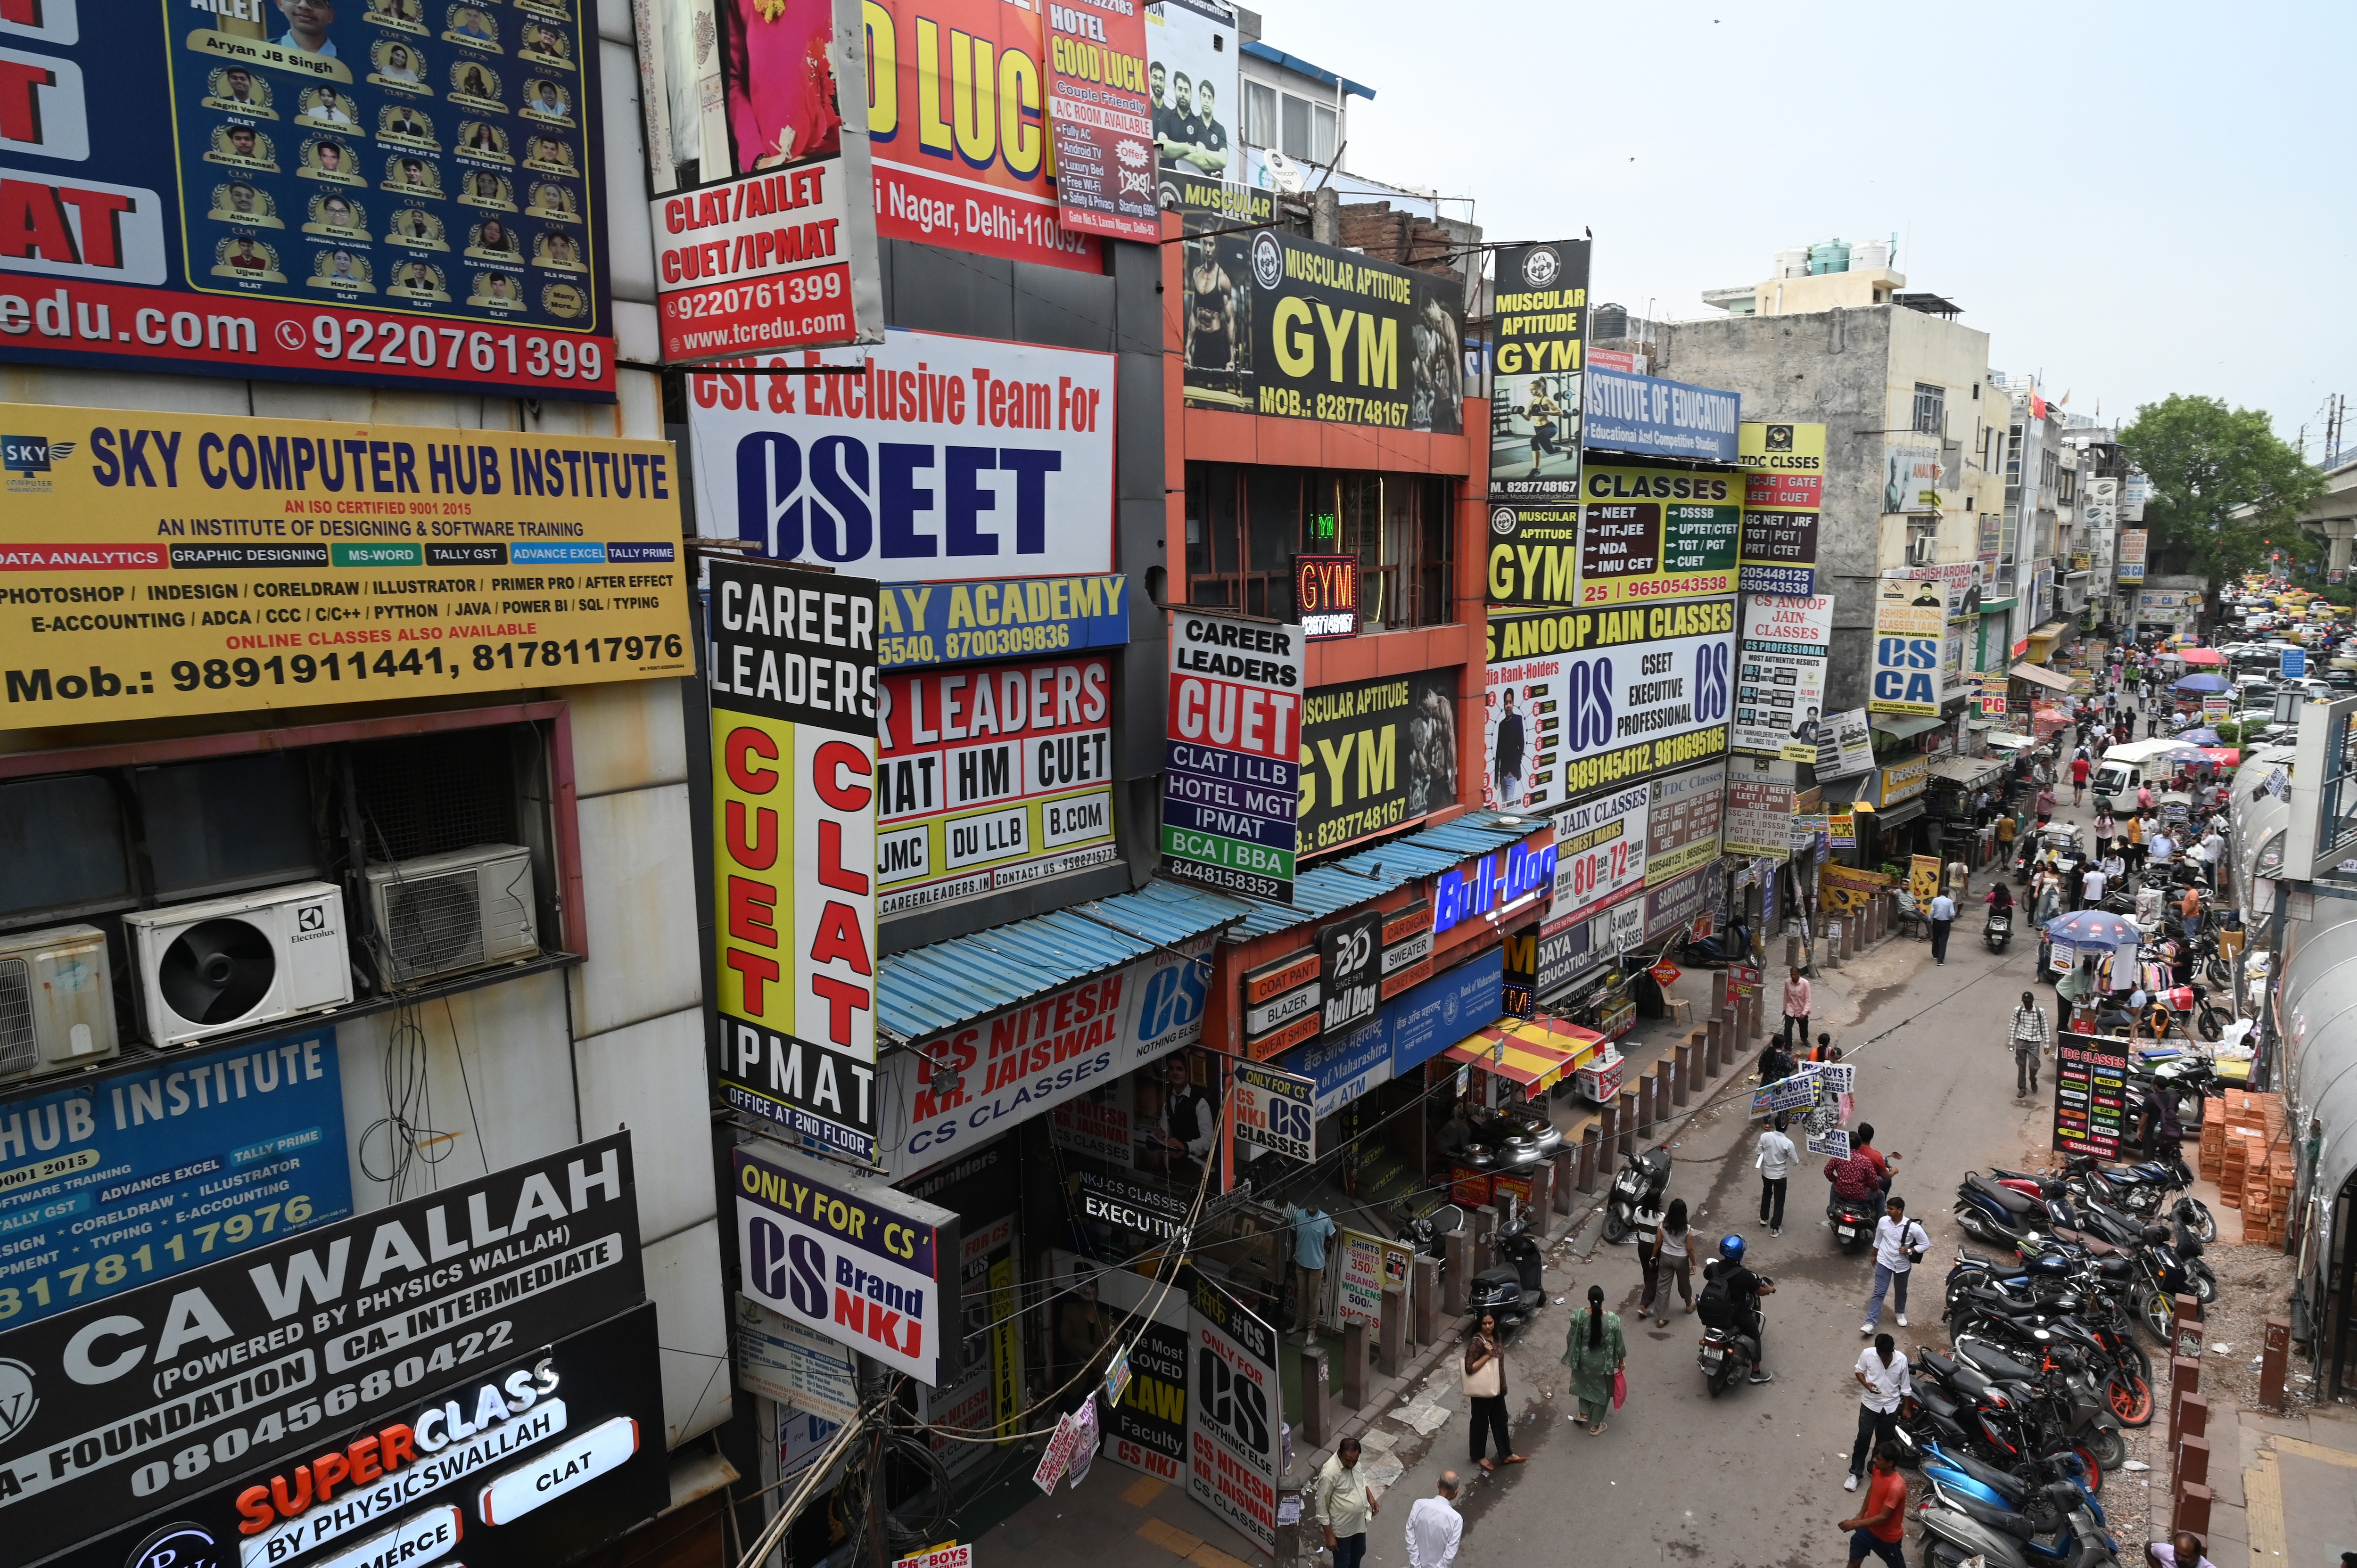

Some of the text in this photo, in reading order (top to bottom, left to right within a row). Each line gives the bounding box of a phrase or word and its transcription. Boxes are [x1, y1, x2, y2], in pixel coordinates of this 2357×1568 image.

[1050, 4, 1106, 43] HOTEL
[206, 36, 333, 74] Aryan JB Singh
[1052, 34, 1146, 95] GOOD LUCK
[1058, 81, 1146, 115] Couple Friendly
[1056, 100, 1149, 136] A/C ROOM AVAILABLE
[1065, 158, 1104, 176] Luxury Bed
[1121, 148, 1143, 160] Offer
[665, 166, 825, 234] CLAT/AILET
[662, 218, 838, 284] CUET/IPMAT
[1286, 248, 1410, 305] MUSCULAR APTITUDE
[553, 292, 575, 302] Many
[678, 272, 841, 319] 9220761399
[684, 313, 846, 349] www.tcredu.com
[1272, 296, 1398, 390] GYM
[312, 315, 602, 381] 9220761399
[1497, 339, 1580, 373] GYM
[972, 368, 1099, 433] Team For
[1316, 394, 1409, 427] 8287748167
[1652, 384, 1735, 434] OF EDUCATION
[1591, 423, 1637, 443] Educational
[1639, 431, 1653, 443] And
[1655, 433, 1694, 449] Competitive
[91, 427, 668, 500] SKY COMPUTER HUB INSTITUTE
[1588, 474, 1728, 501] CLASSES
[285, 500, 471, 516] AN ISO CERTIFIED 9001 2015
[1602, 507, 1636, 518] NEET
[1680, 507, 1714, 518] DSSSB
[1601, 524, 1644, 536] IIT-JEE
[172, 550, 327, 562] GRAPHIC DESIGNING
[348, 550, 414, 561] MS-WORD
[1599, 543, 1628, 554] NDA
[1677, 556, 1705, 567] CUET
[1629, 576, 1727, 597] 9650543538
[2132, 566, 2143, 575] CA
[722, 580, 873, 651] CAREER
[948, 576, 1124, 629] ACADEMY
[1755, 595, 1827, 610] CS ANOOP
[1772, 611, 1805, 624] JAIN
[32, 613, 185, 632] E-ACCOUNTING
[226, 622, 537, 649] ONLINE CLASSES ALSO AVAILABLE
[1186, 619, 1290, 657] CAREER
[1502, 603, 1732, 659] ANOOP JAIN CLASSES
[1755, 624, 1819, 640] CLASSES
[1879, 620, 1941, 632] CLASSES (AAC)
[946, 624, 1069, 659] 8700309836
[1746, 641, 1825, 656] CS PROFESSIONAL
[1879, 638, 1937, 669] CS
[5, 634, 683, 703] Mob.: 9891911441, 8178117976
[1765, 656, 1795, 665] AUTHENTIC
[1797, 658, 1820, 666] RESULTS
[1629, 678, 1683, 706] EXECUTIVE
[1875, 671, 1935, 703] CA
[910, 663, 1107, 746] LEADERS
[1178, 678, 1294, 756] CUET
[1617, 703, 1692, 739] PROFESSIONAL
[1982, 698, 2005, 712] PG
[1173, 747, 1287, 786] CLAT LLB
[1567, 729, 1725, 793] 9891454112, 9818695185
[1731, 783, 1791, 795] IIT-JEE NEET
[1050, 803, 1103, 836] B.COM
[1561, 787, 1647, 836] JAIN CLASSES
[1172, 860, 1278, 897] 8448158352
[1435, 842, 1557, 934] Bull-Dog
[1574, 854, 1596, 897] 80
[291, 930, 335, 943] Electrolux
[1260, 962, 1315, 996] COAT PANT
[1335, 972, 1364, 990] SINCE 1978
[1461, 984, 1471, 998] Bank
[1472, 982, 1476, 993] of
[1476, 969, 1500, 991] Maharashtra
[989, 973, 1124, 1065] NITESH
[1268, 994, 1307, 1023] BLAZER
[981, 1013, 1117, 1095] JAISWAL
[2061, 1048, 2125, 1068] TDC CLASSES
[112, 1038, 323, 1130] INSTITUTE
[1340, 1076, 1366, 1106] ATM
[1788, 1078, 1809, 1092] BOYS
[1789, 1089, 1811, 1097] FACILITIES
[909, 1051, 1110, 1155] CS CLASSES
[729, 1089, 865, 1155] OFFICE AT 2ND FLOOR
[2069, 1142, 2111, 1156] 9205448125
[200, 1158, 300, 1197] ILLUSTRATOR
[741, 1164, 865, 1241] ONLY FOR
[91, 1222, 152, 1248] TYPING
[1351, 1240, 1379, 1254] SHIRTS
[63, 1149, 624, 1385] CA WALLAH
[1345, 1247, 1380, 1264] T-SHIRTS
[1352, 1258, 1376, 1275] 350/-
[835, 1255, 923, 1319] Brand
[1342, 1281, 1381, 1301] WOLLENS
[1345, 1272, 1379, 1290] BRANDS
[152, 1225, 570, 1397] (POWERED BY PHYSICS WALLAH)
[1349, 1294, 1372, 1308] 500/-
[834, 1288, 921, 1361] NKJ
[131, 1320, 512, 1497] 08045680422
[1121, 1415, 1183, 1455] Faculty
[536, 1451, 593, 1492] CLAT
